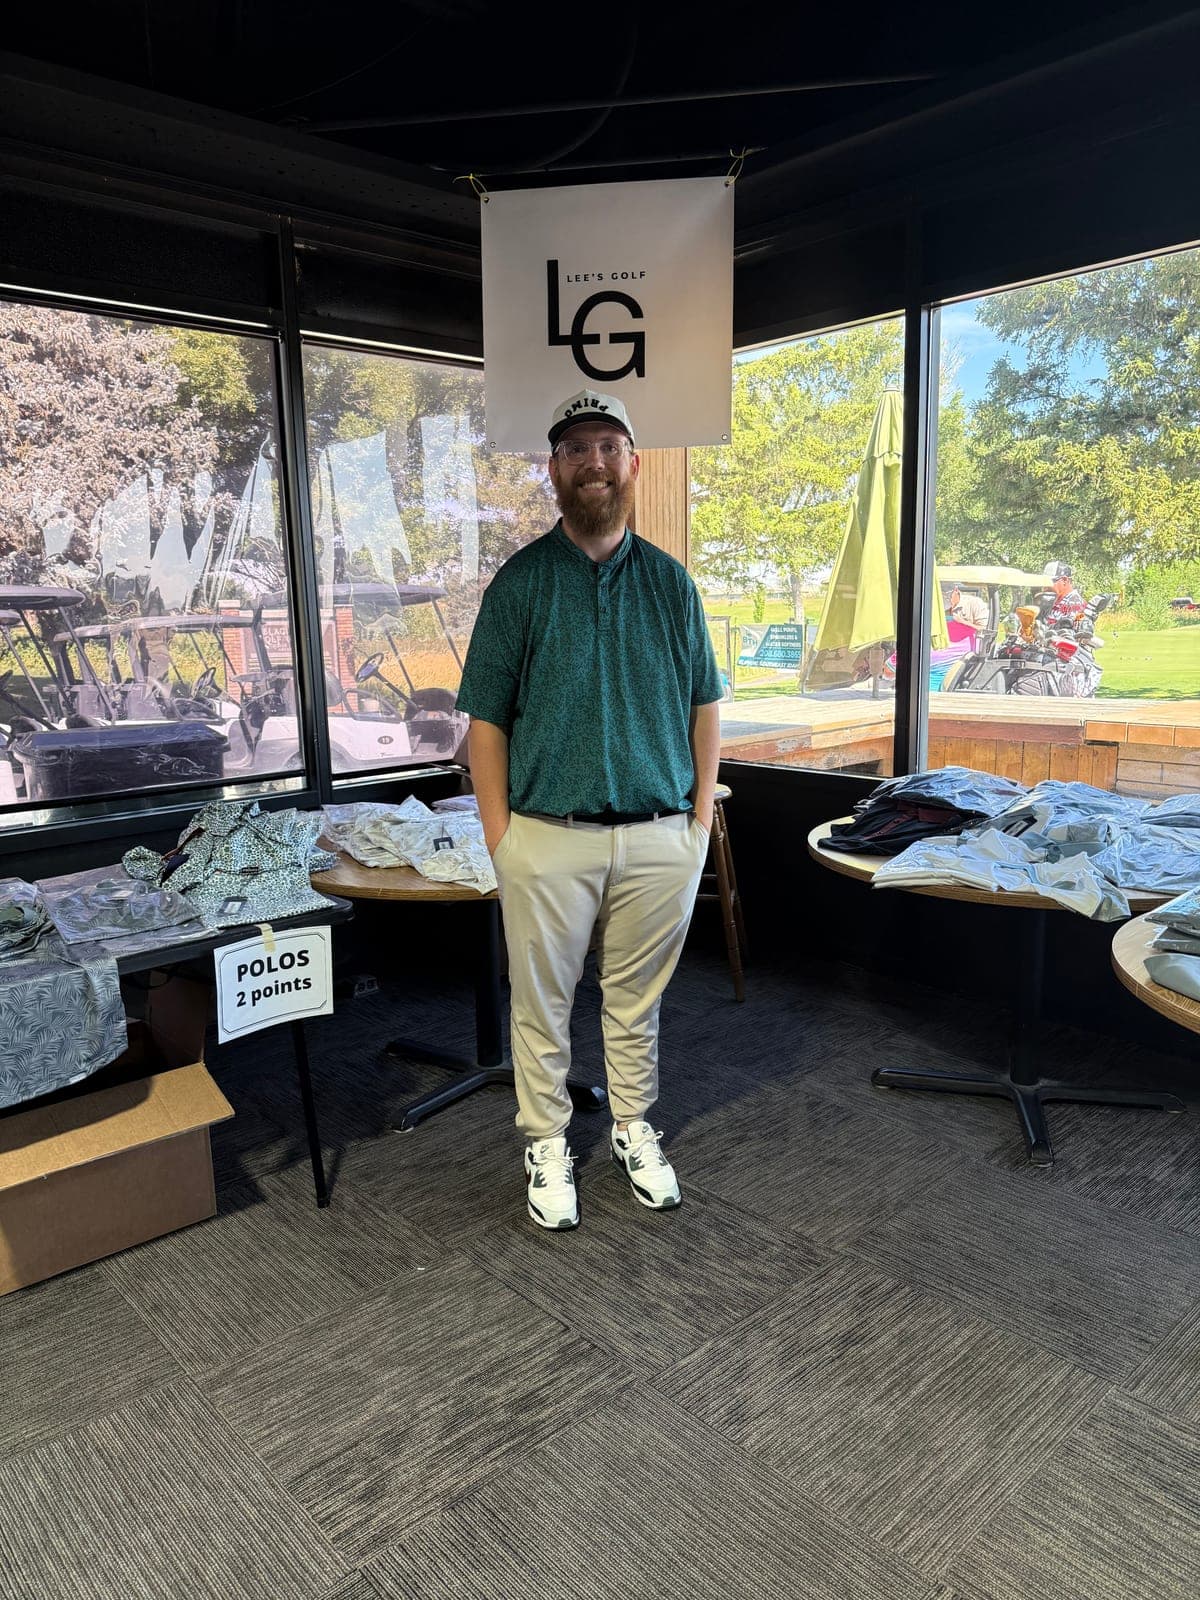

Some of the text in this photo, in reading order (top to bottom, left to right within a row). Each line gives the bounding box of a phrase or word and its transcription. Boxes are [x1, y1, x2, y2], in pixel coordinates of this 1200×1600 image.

[566, 271, 647, 283] LEE'S GOLF
[564, 398, 609, 418] PRIMO
[237, 949, 310, 982] POLOS
[236, 977, 312, 1007] 2 points
